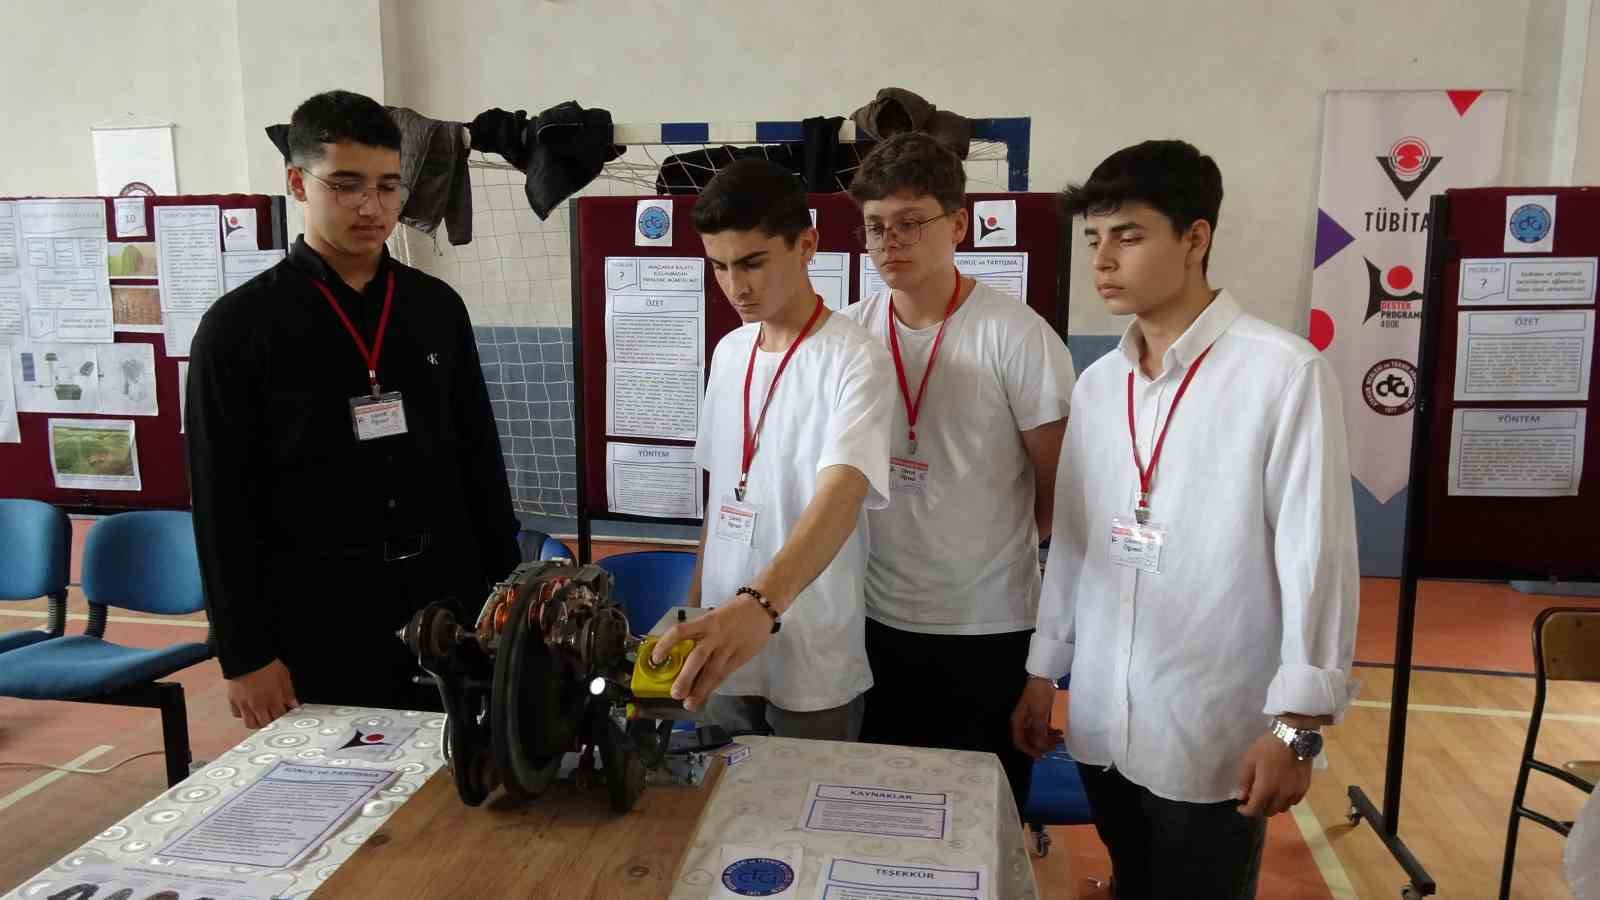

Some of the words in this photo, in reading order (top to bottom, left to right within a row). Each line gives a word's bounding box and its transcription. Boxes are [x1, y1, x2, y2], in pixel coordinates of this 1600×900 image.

[1364, 207, 1430, 232] TÜBİTA
[1514, 316, 1540, 327] ÖZET
[1497, 414, 1541, 424] YÖNTEM
[639, 447, 670, 457] YÖNTEM
[850, 789, 913, 801] KAYNAKLAR
[875, 867, 935, 880] TEŞEKKÜR
